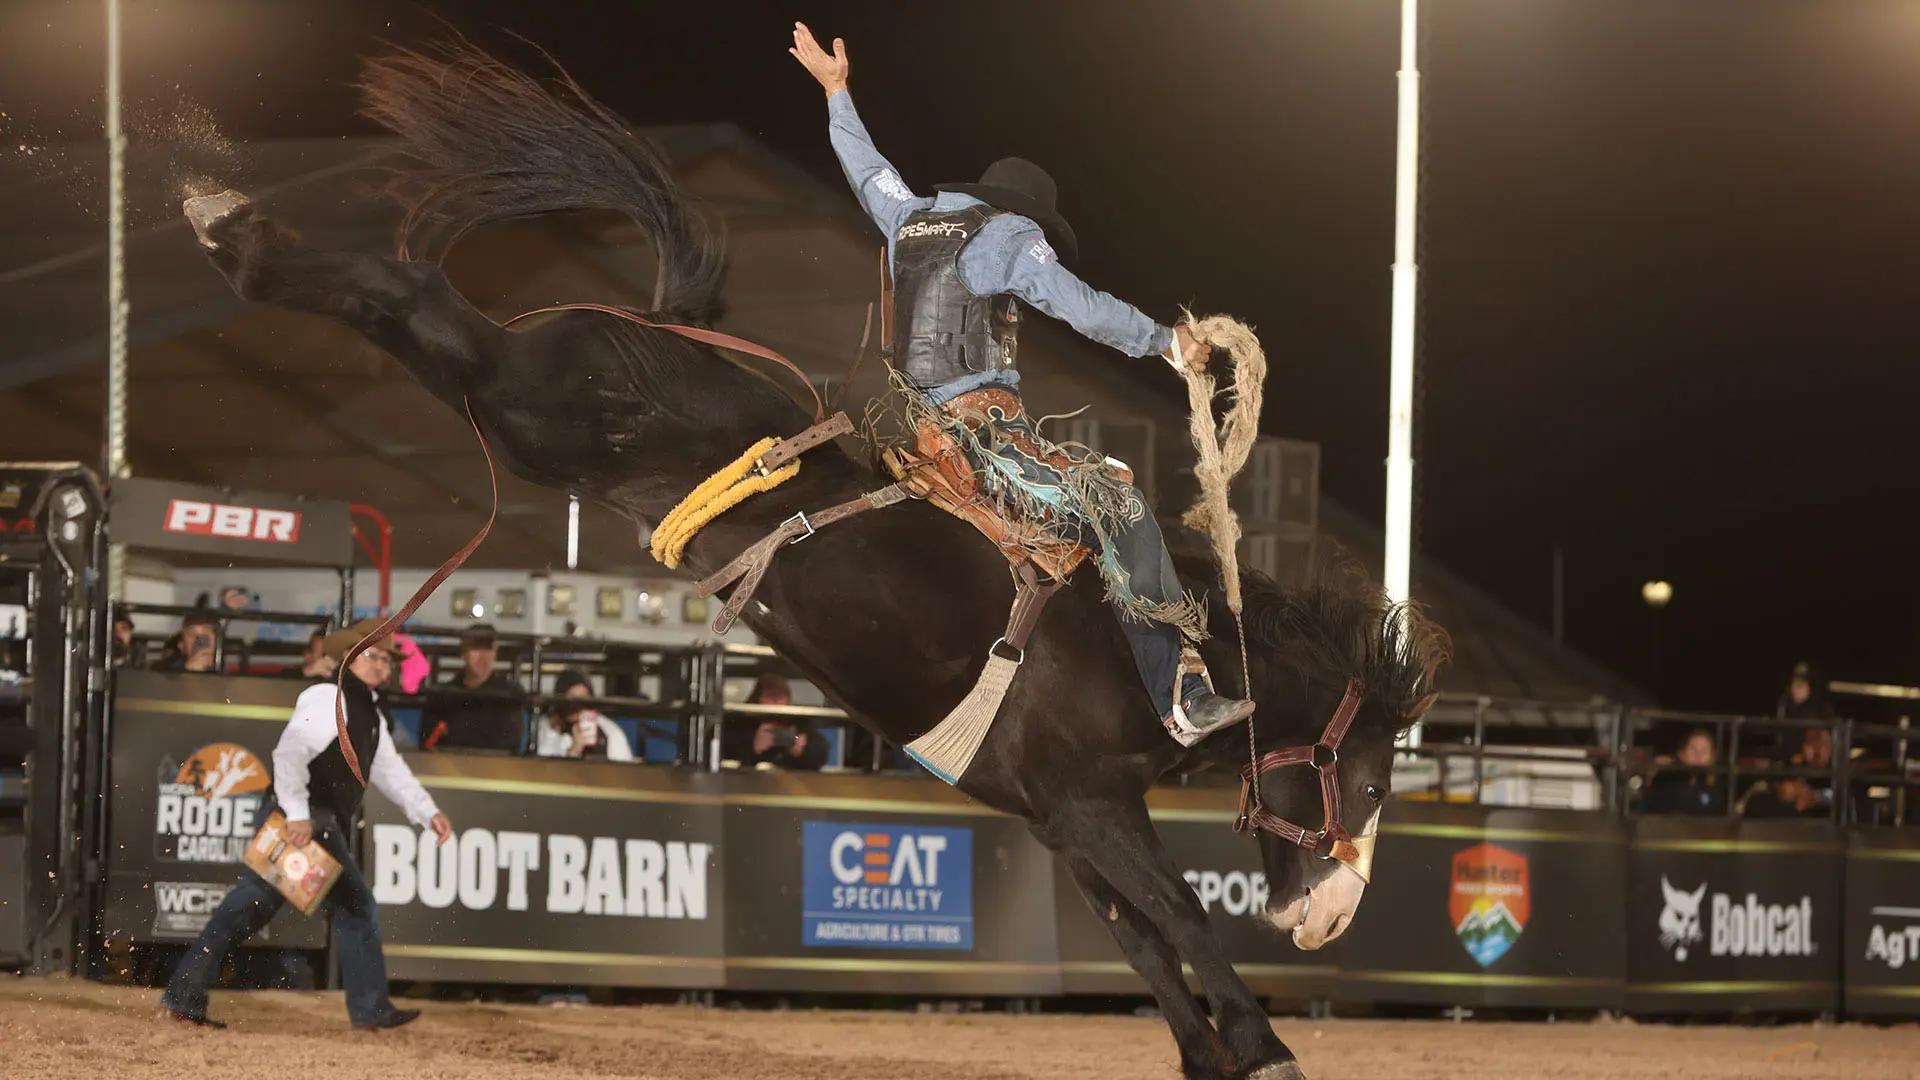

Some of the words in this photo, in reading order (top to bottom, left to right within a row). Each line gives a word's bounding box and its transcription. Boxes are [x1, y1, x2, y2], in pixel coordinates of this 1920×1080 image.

[168, 500, 296, 541] PBR
[157, 795, 260, 836] RODE
[373, 824, 540, 910] BOOT
[547, 834, 713, 919] BARN
[830, 831, 947, 886] CEAT
[832, 885, 943, 911] SPECIALTY
[815, 921, 890, 941] AGRICULTURE
[1711, 893, 1812, 956] Bobcat
